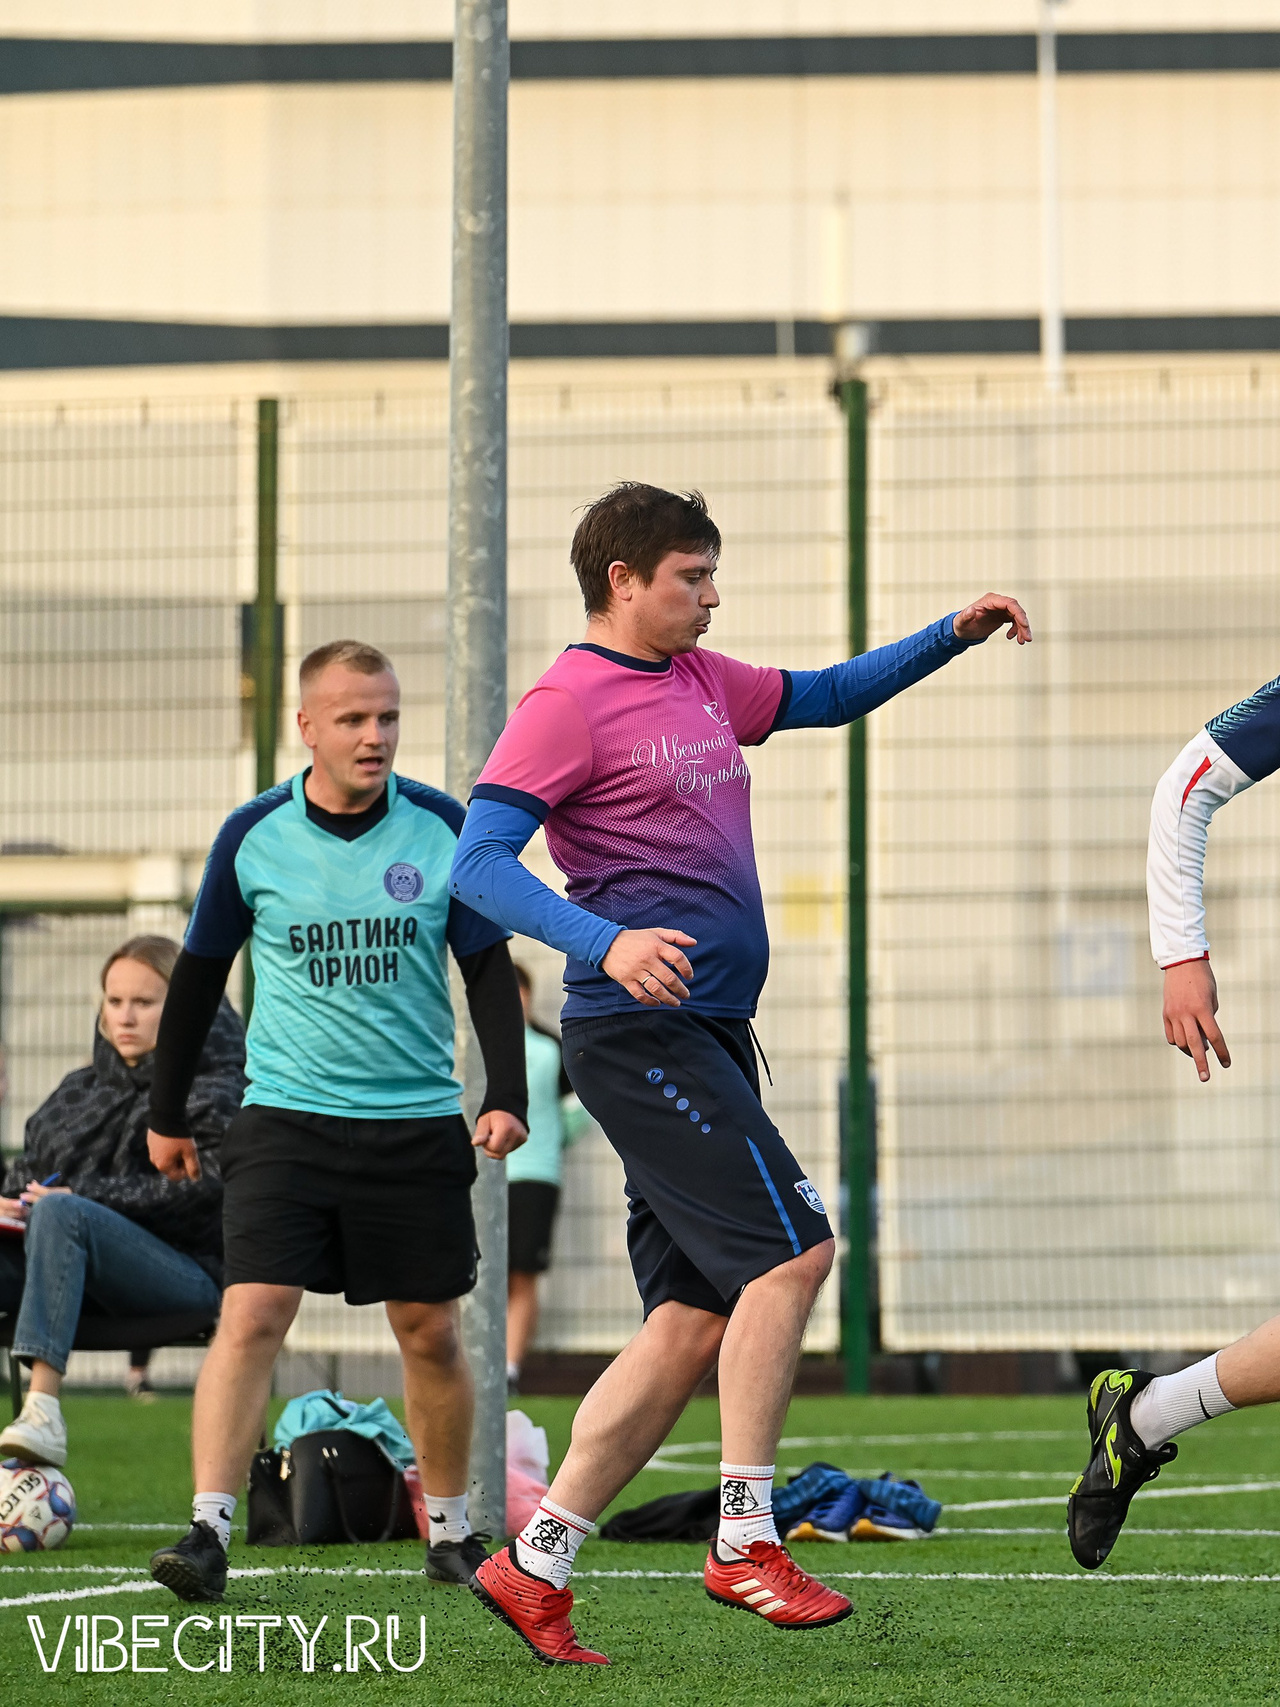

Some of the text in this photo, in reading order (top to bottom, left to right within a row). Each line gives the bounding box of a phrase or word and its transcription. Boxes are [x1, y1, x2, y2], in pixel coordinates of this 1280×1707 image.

[631, 729, 728, 776] Цветной
[288, 916, 418, 954] БАЛТИКА
[308, 951, 399, 988] ОРИОН
